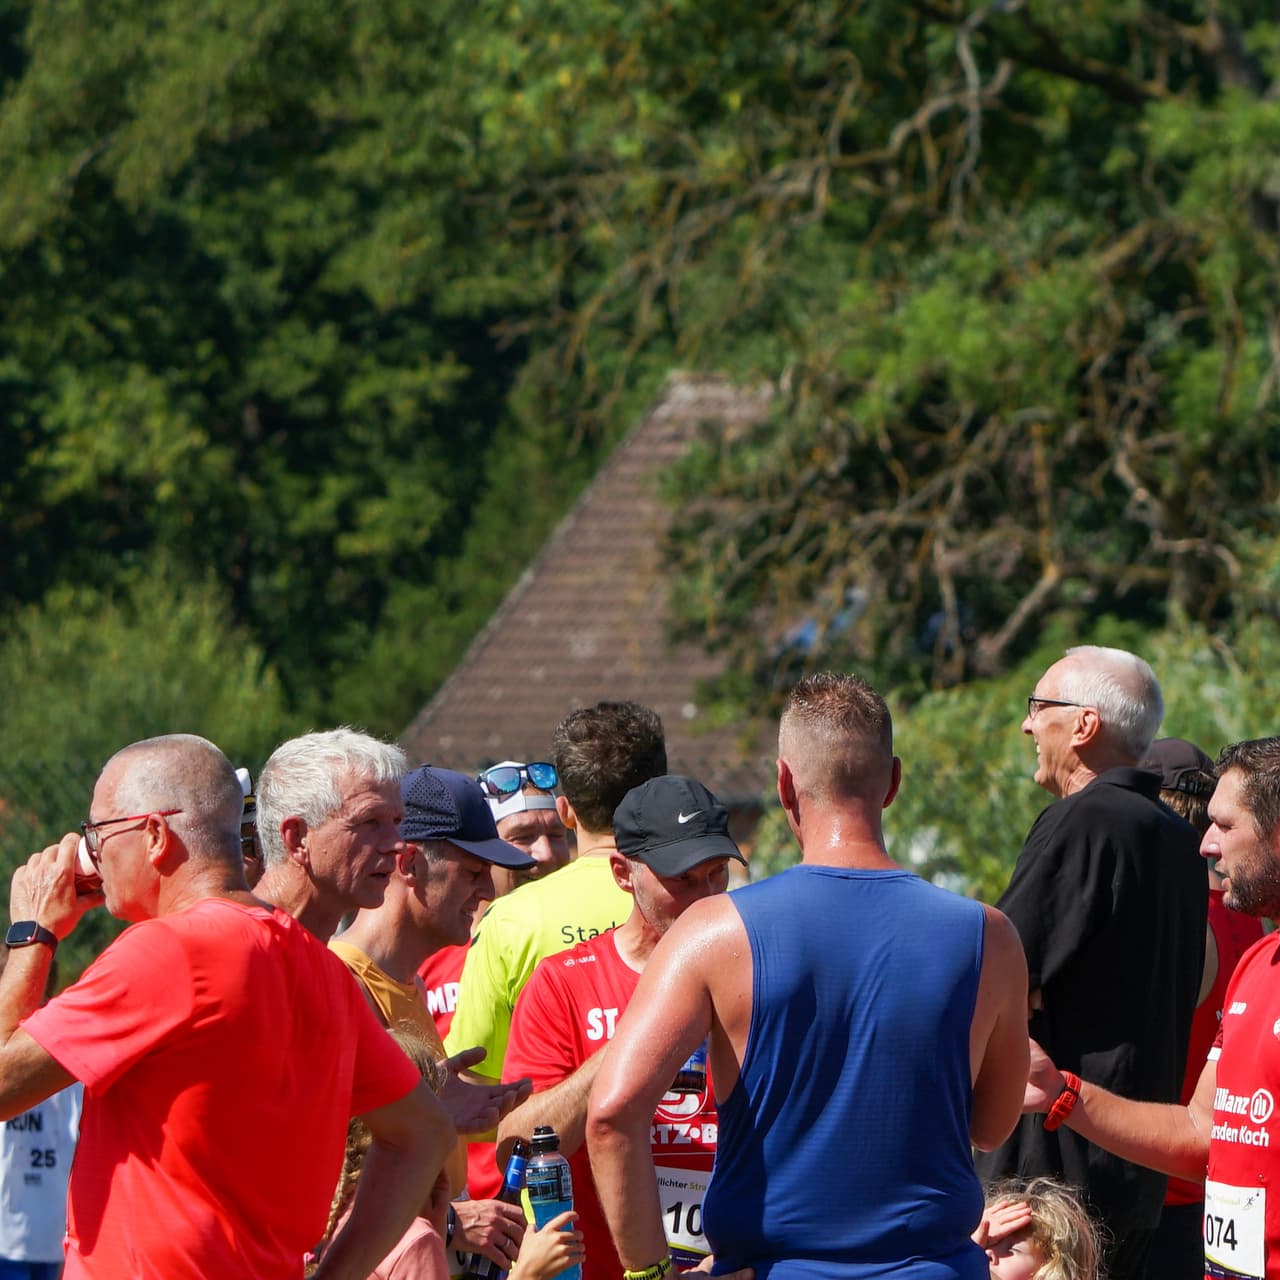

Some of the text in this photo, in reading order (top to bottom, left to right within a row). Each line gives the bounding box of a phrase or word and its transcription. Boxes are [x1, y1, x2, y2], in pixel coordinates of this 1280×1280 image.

[1240, 1125, 1270, 1148] Koch
[31, 1148, 57, 1169] 25
[1206, 1213, 1239, 1252] 074
